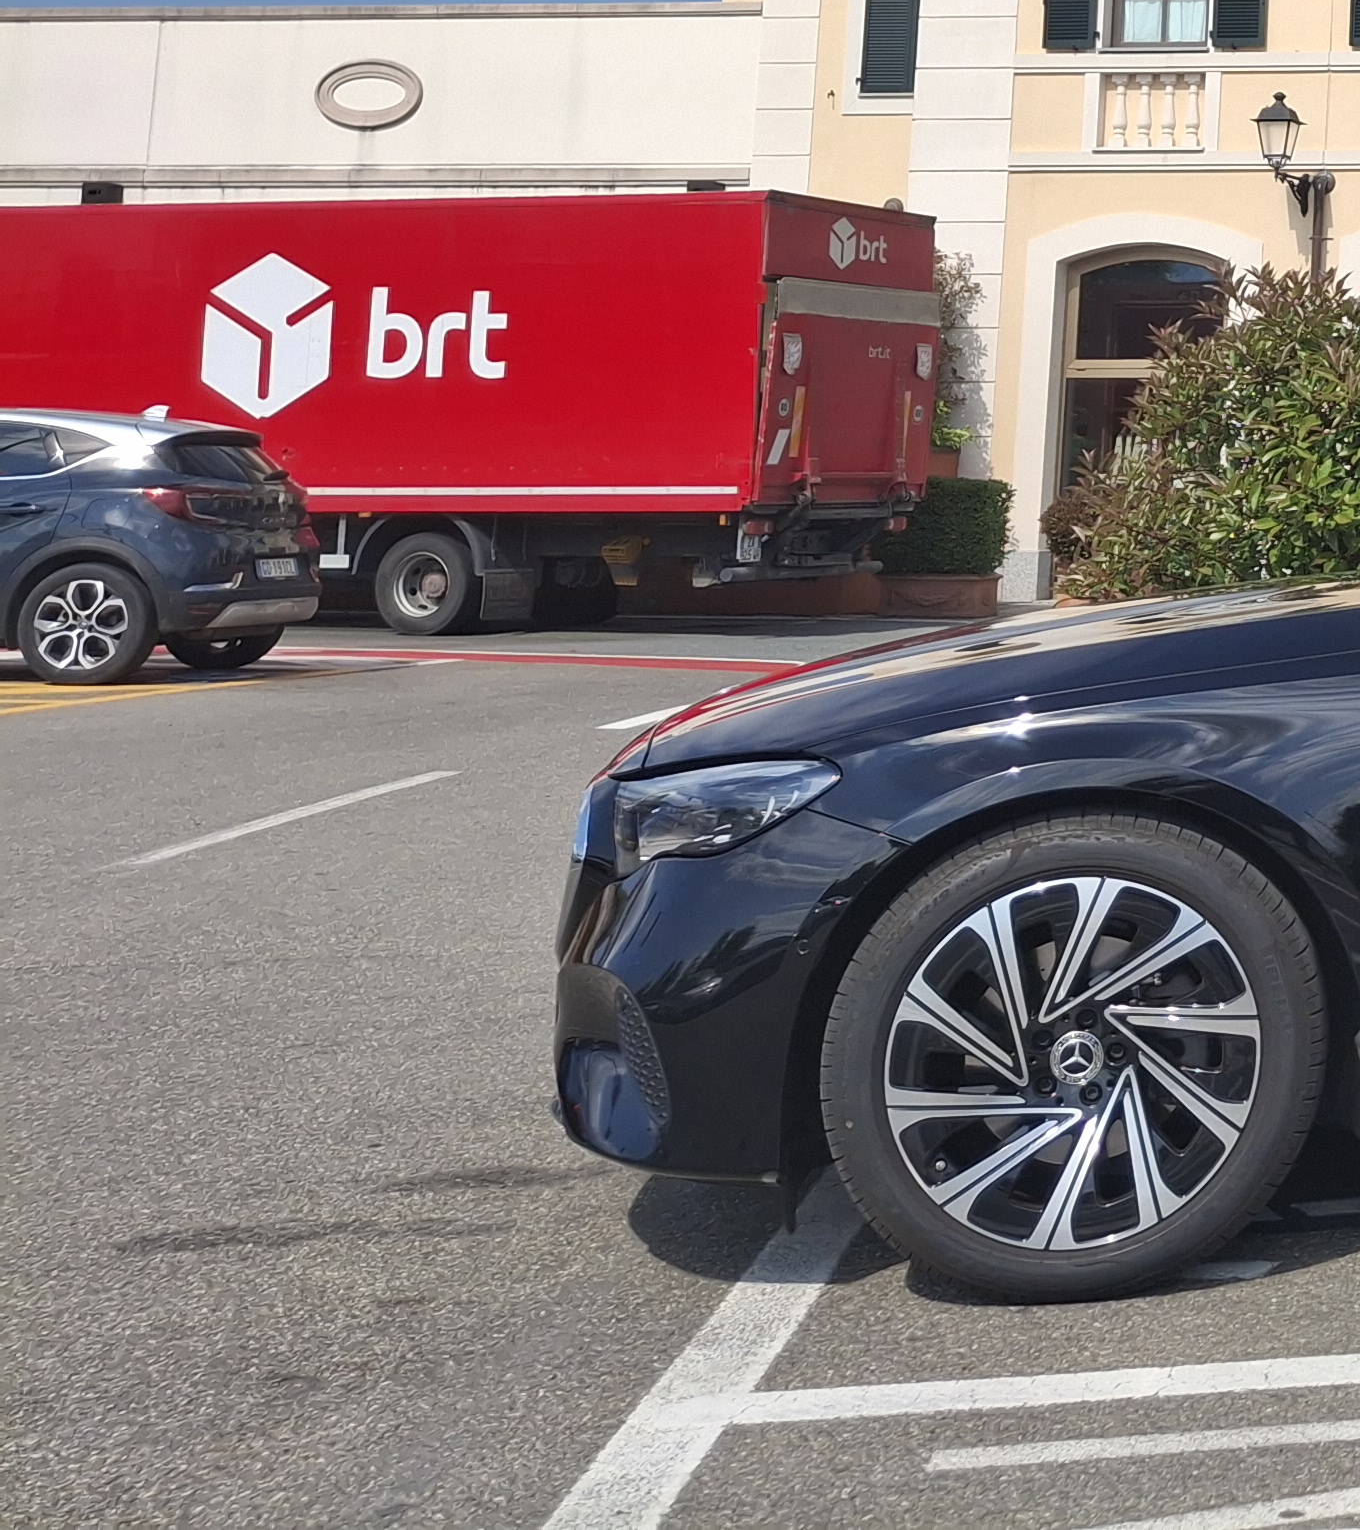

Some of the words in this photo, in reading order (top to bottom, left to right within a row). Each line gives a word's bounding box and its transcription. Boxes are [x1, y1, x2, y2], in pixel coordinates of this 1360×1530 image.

[859, 231, 888, 263] brt
[366, 286, 509, 380] brt
[868, 345, 890, 359] brt.it
